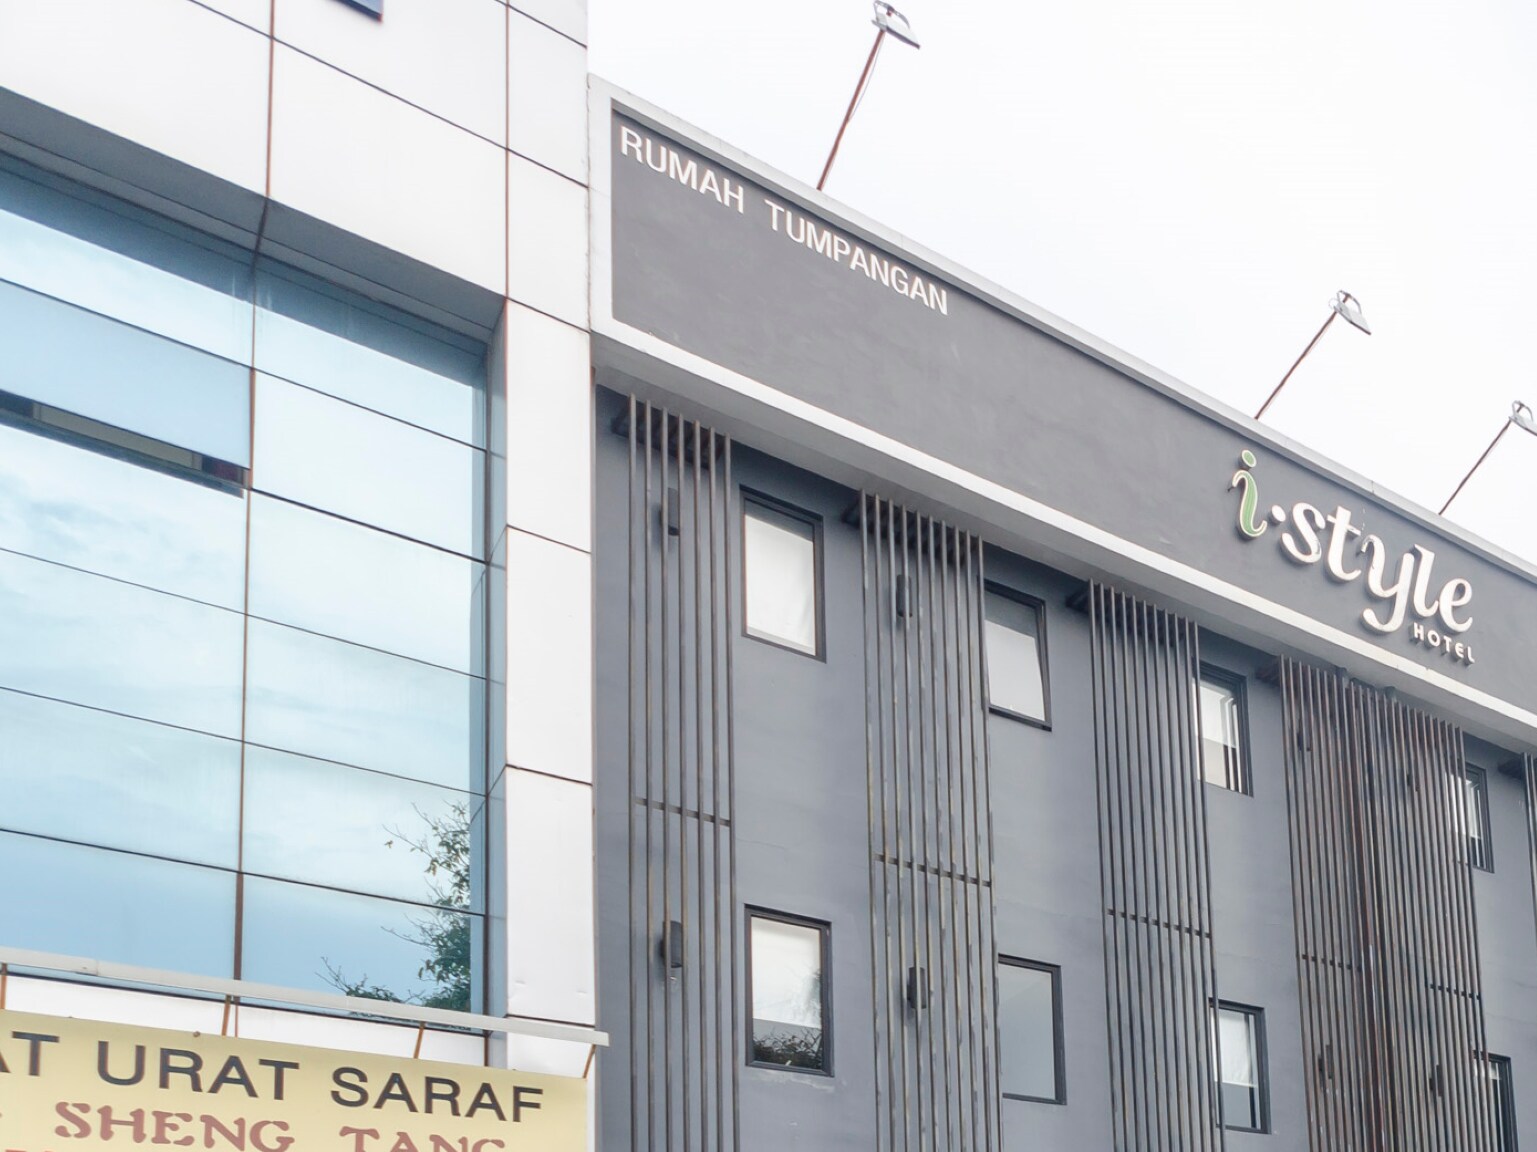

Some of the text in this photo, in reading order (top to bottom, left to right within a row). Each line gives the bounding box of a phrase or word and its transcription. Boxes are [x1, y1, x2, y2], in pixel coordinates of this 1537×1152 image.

[620, 126, 948, 316] RUMAH TUMPANGAN
[1412, 622, 1475, 664] HOTEL
[0, 1031, 543, 1122] T URAT SARAF
